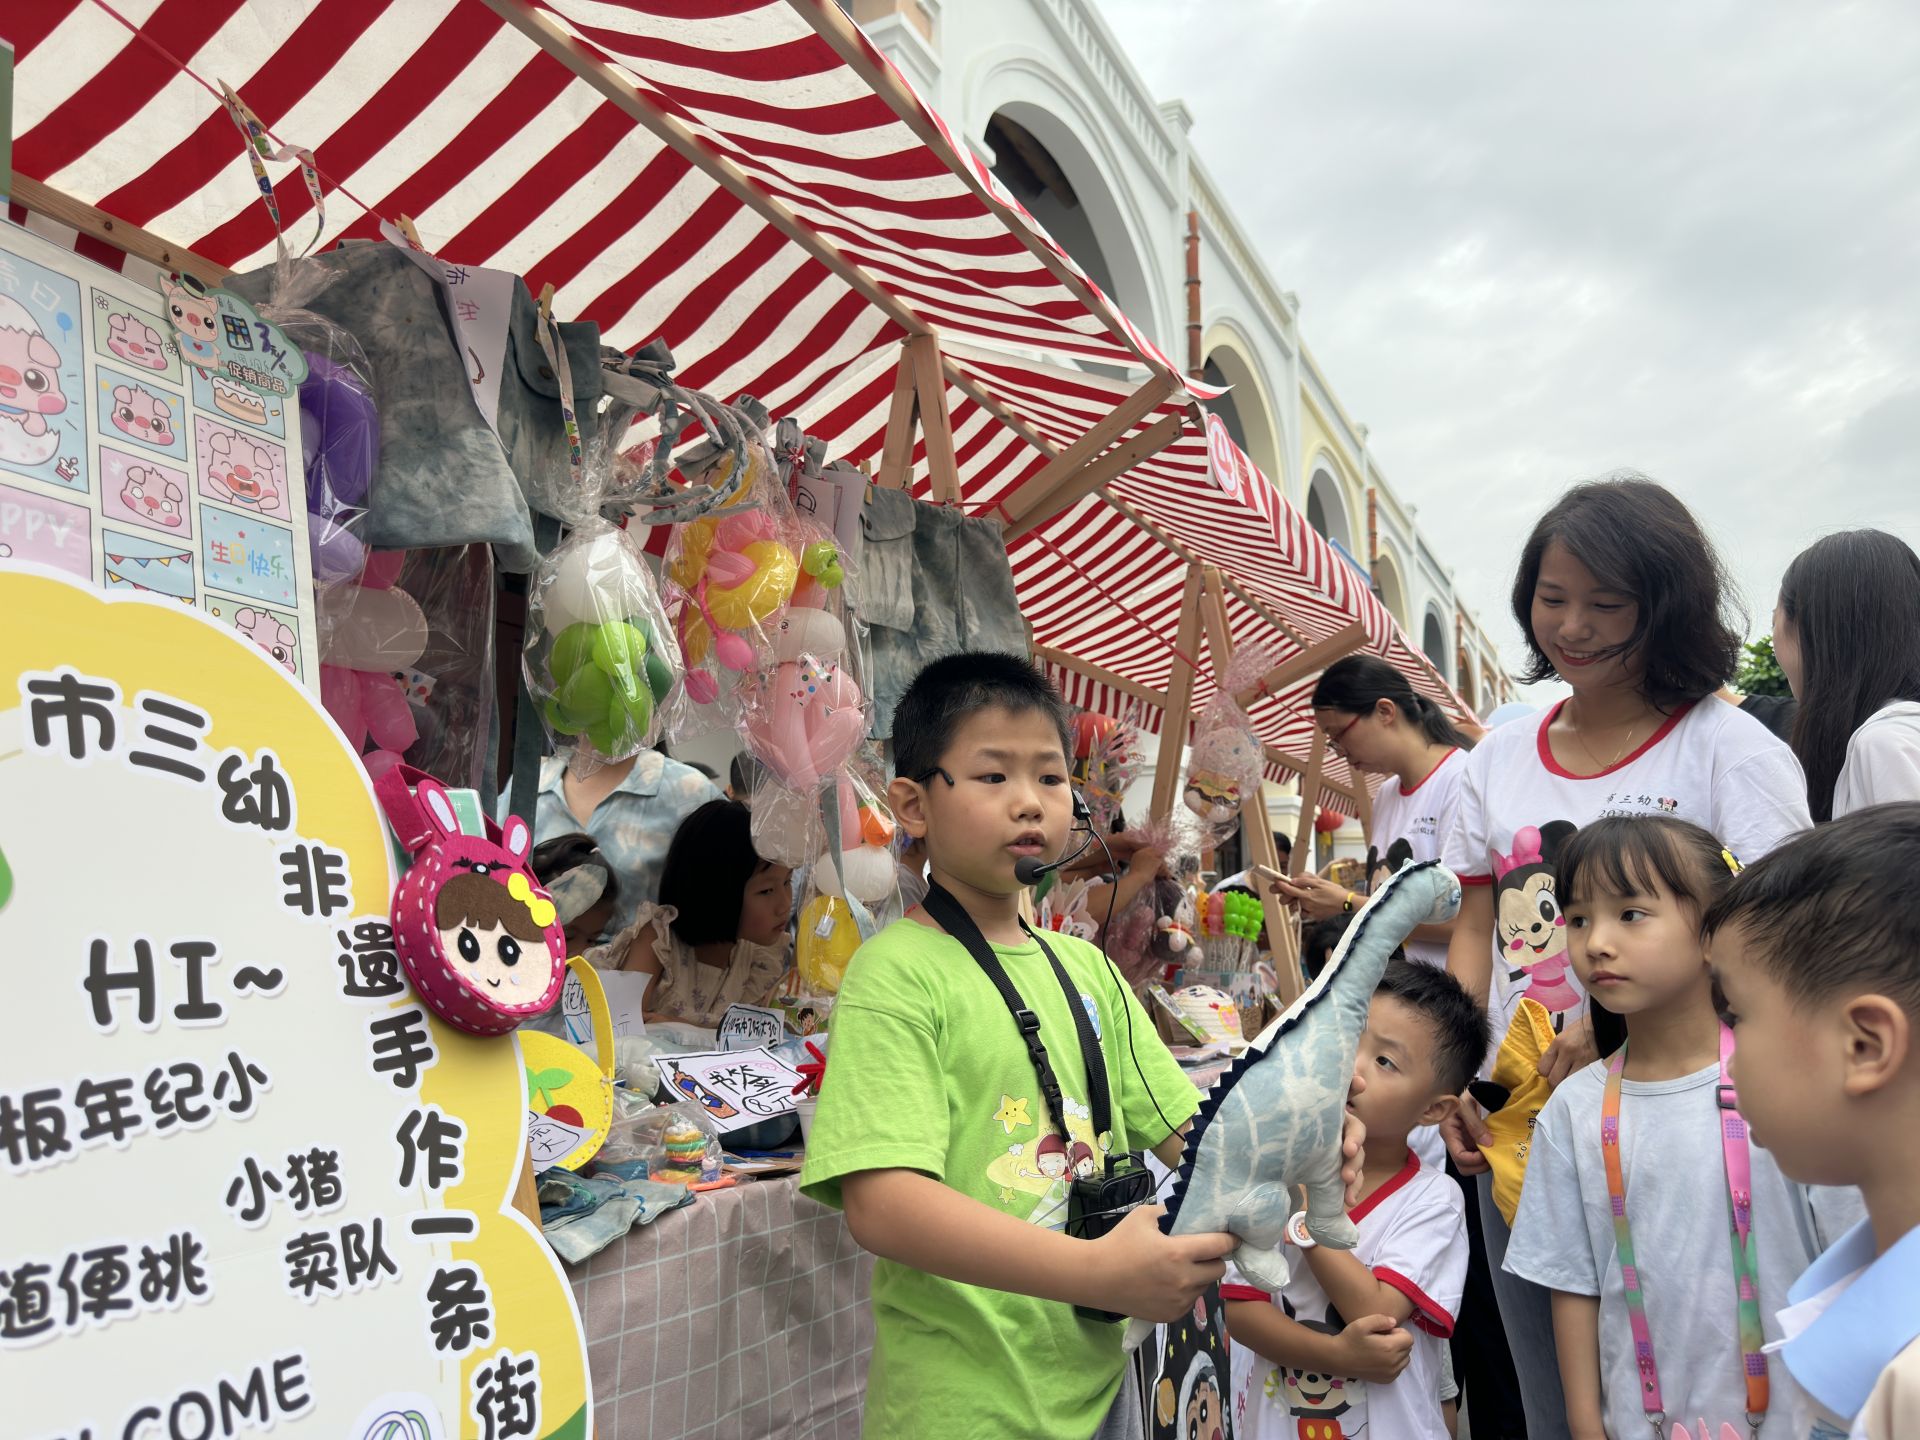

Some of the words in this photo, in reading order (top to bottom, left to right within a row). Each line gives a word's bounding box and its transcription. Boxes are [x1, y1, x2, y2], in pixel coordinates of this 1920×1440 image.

[227, 360, 287, 394] 促销商品
[211, 540, 289, 580] 生日快乐
[709, 1063, 778, 1096] 书签
[749, 1090, 797, 1112] 8元
[226, 1147, 342, 1222] 小猪
[285, 1217, 397, 1297] 卖队
